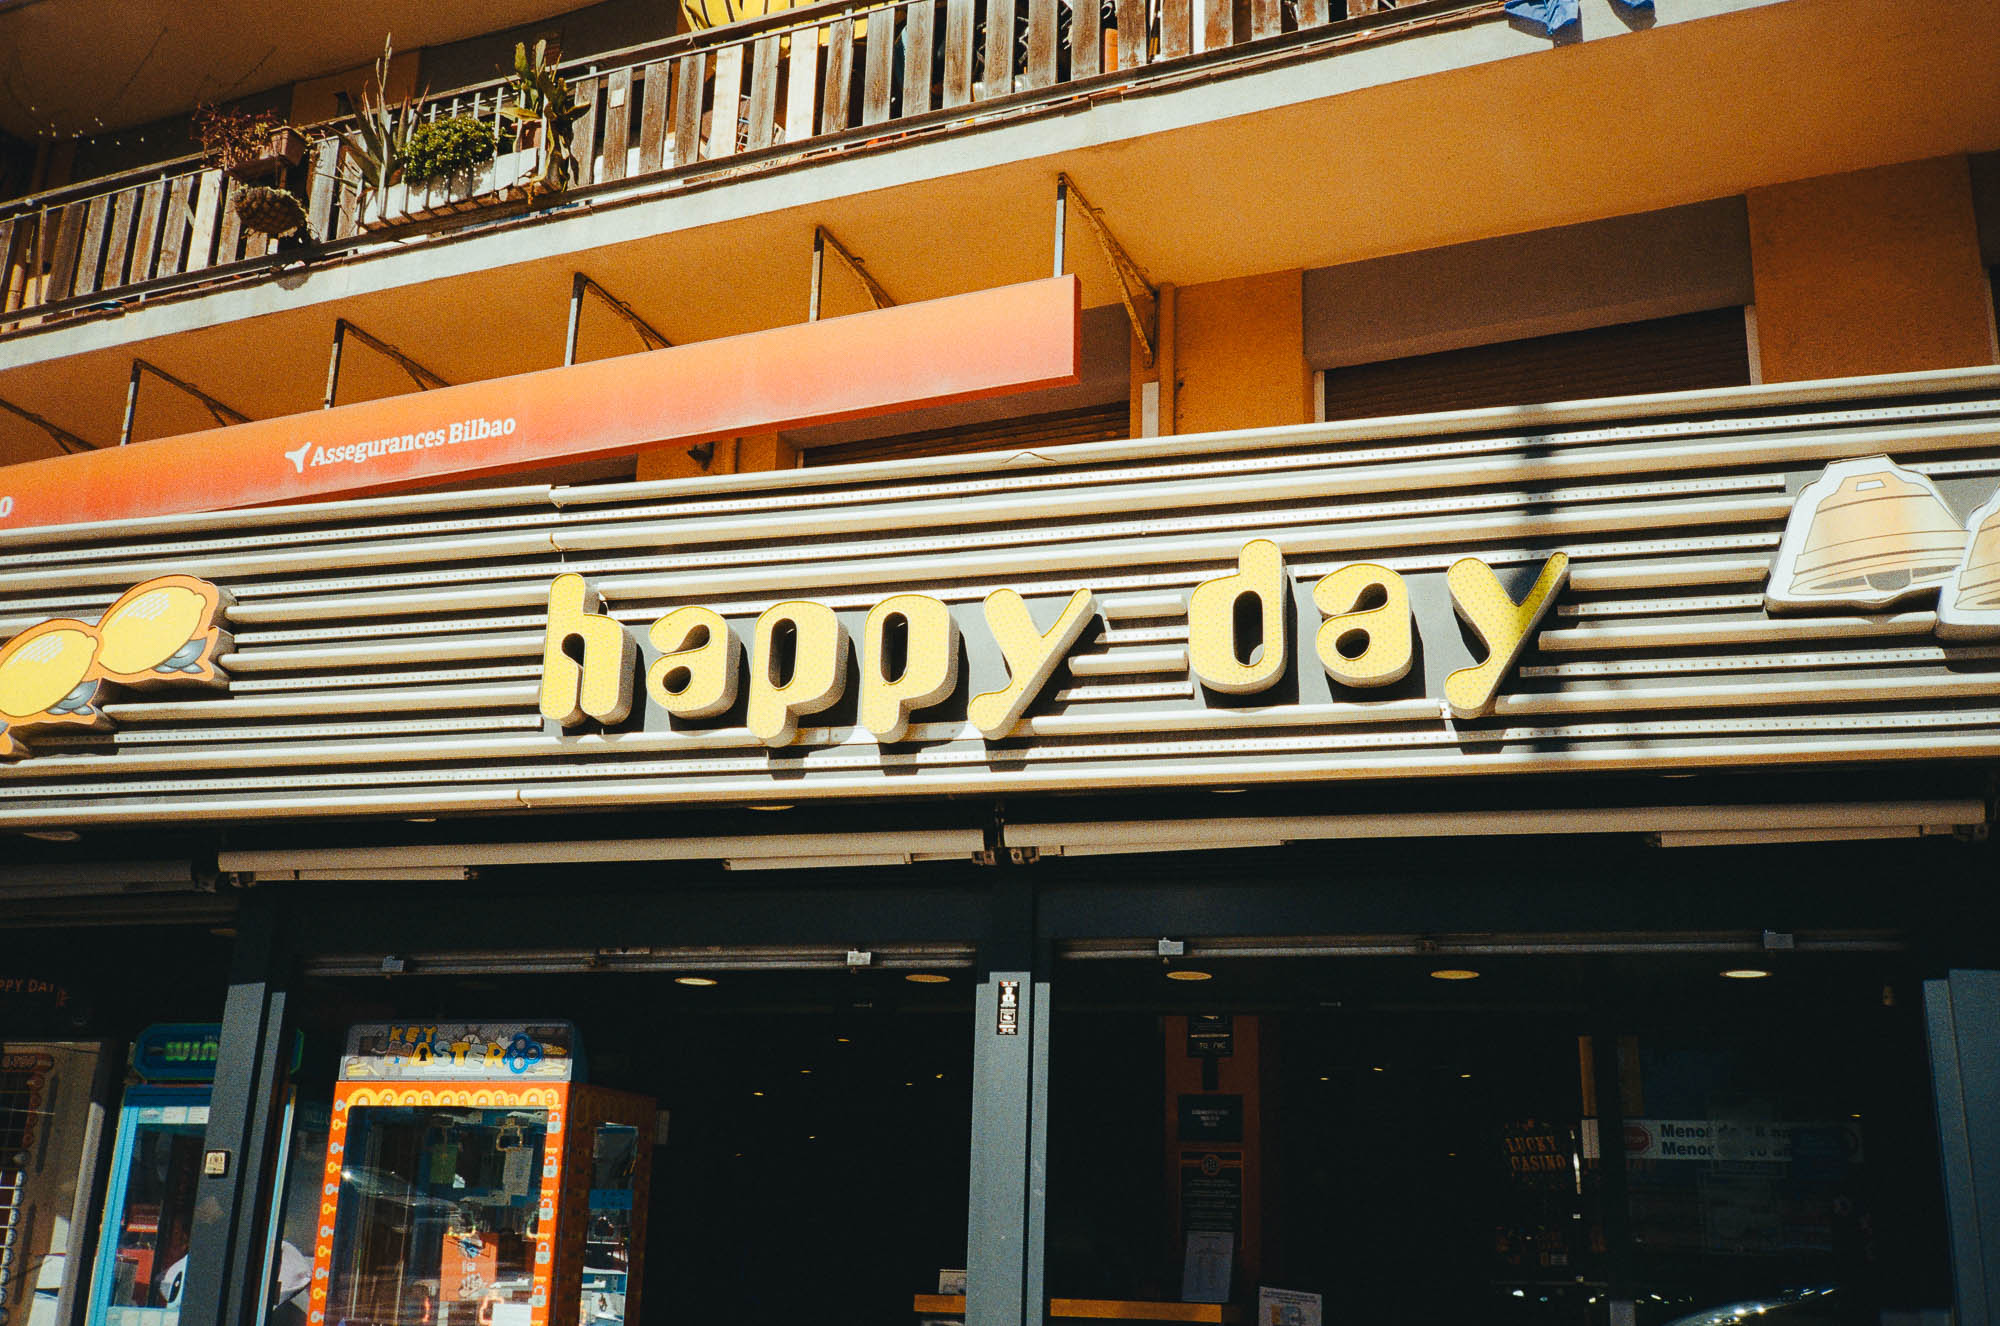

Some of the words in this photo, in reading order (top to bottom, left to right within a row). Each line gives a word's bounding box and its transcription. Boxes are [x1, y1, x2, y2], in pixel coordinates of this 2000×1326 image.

[310, 428, 446, 467] Assegurances
[447, 417, 516, 445] Bilbao
[540, 572, 1097, 747] happy
[1188, 539, 1569, 719] day
[389, 1026, 438, 1043] KEY
[384, 1040, 506, 1068] MASTER
[1504, 1135, 1557, 1153] LUCKY
[1511, 1153, 1567, 1171] CASINO
